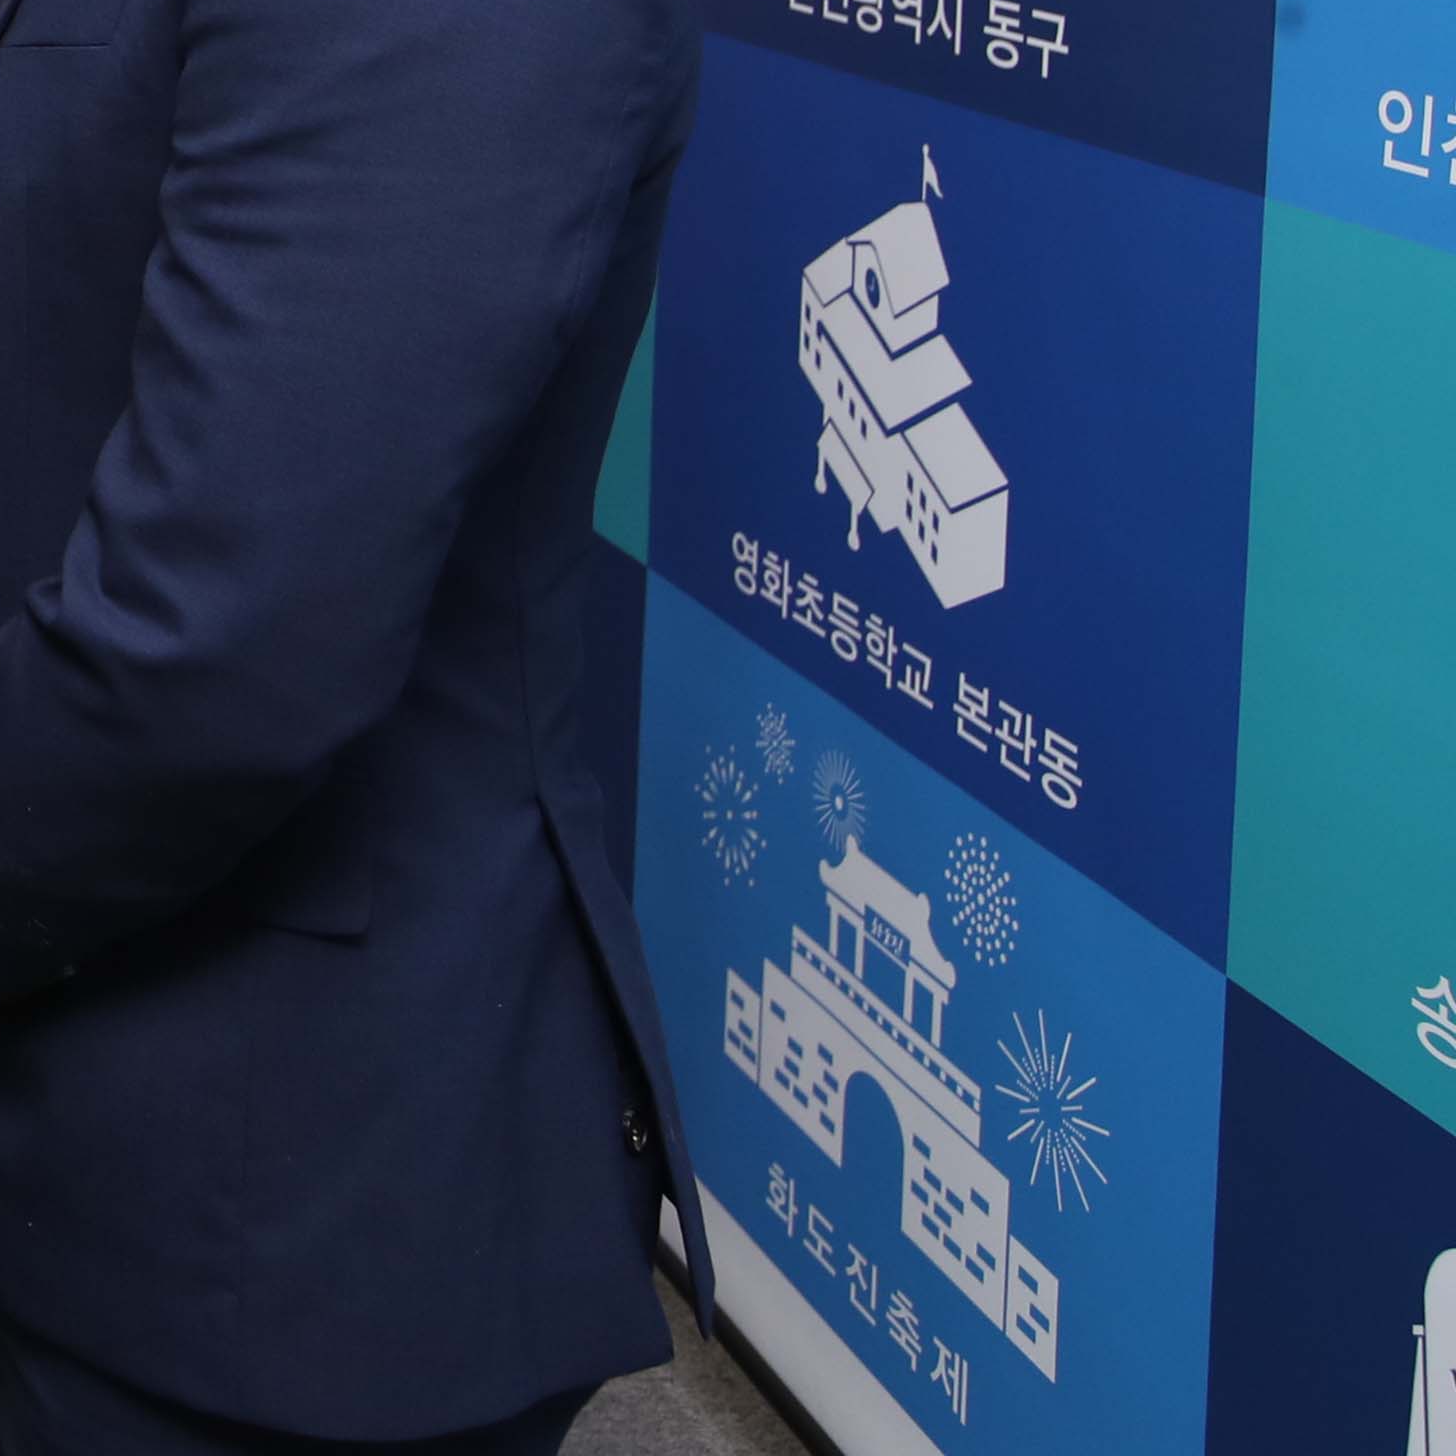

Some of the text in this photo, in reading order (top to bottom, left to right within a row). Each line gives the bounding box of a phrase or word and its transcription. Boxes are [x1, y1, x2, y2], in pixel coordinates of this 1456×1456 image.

[731, 531, 1083, 811] 영화초등학교 본관동
[765, 1161, 968, 1426] 화도진축제
